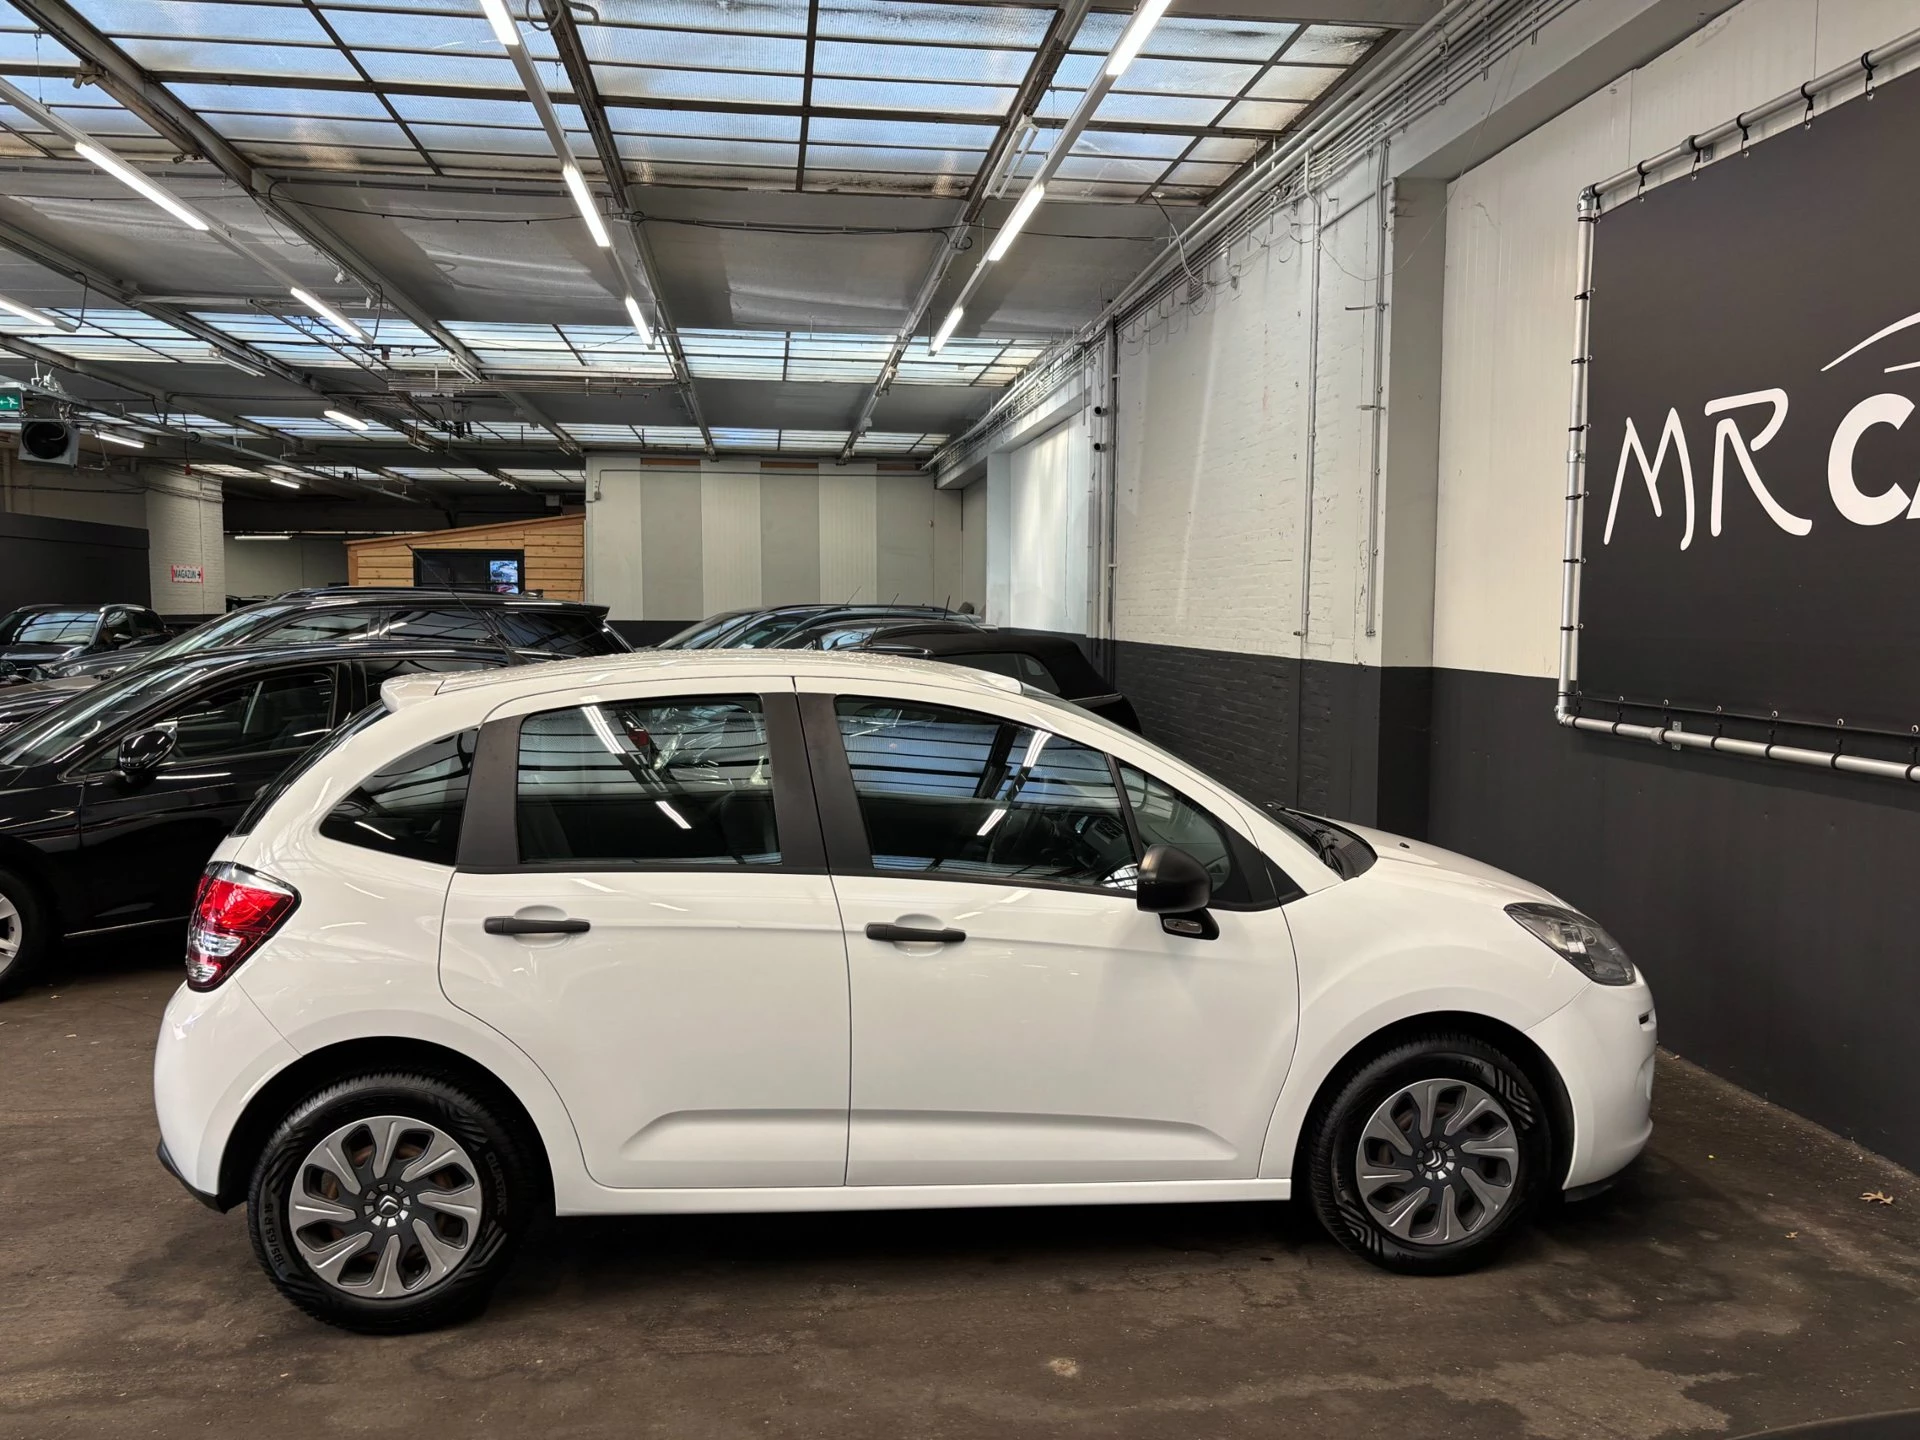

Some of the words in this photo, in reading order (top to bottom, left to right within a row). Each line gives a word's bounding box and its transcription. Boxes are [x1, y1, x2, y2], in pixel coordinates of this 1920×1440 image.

[1603, 387, 1813, 551] MR
[1827, 393, 1920, 526] C
[264, 1202, 274, 1213] 15
[264, 1216, 274, 1225] R
[265, 1227, 285, 1267] 185/65
